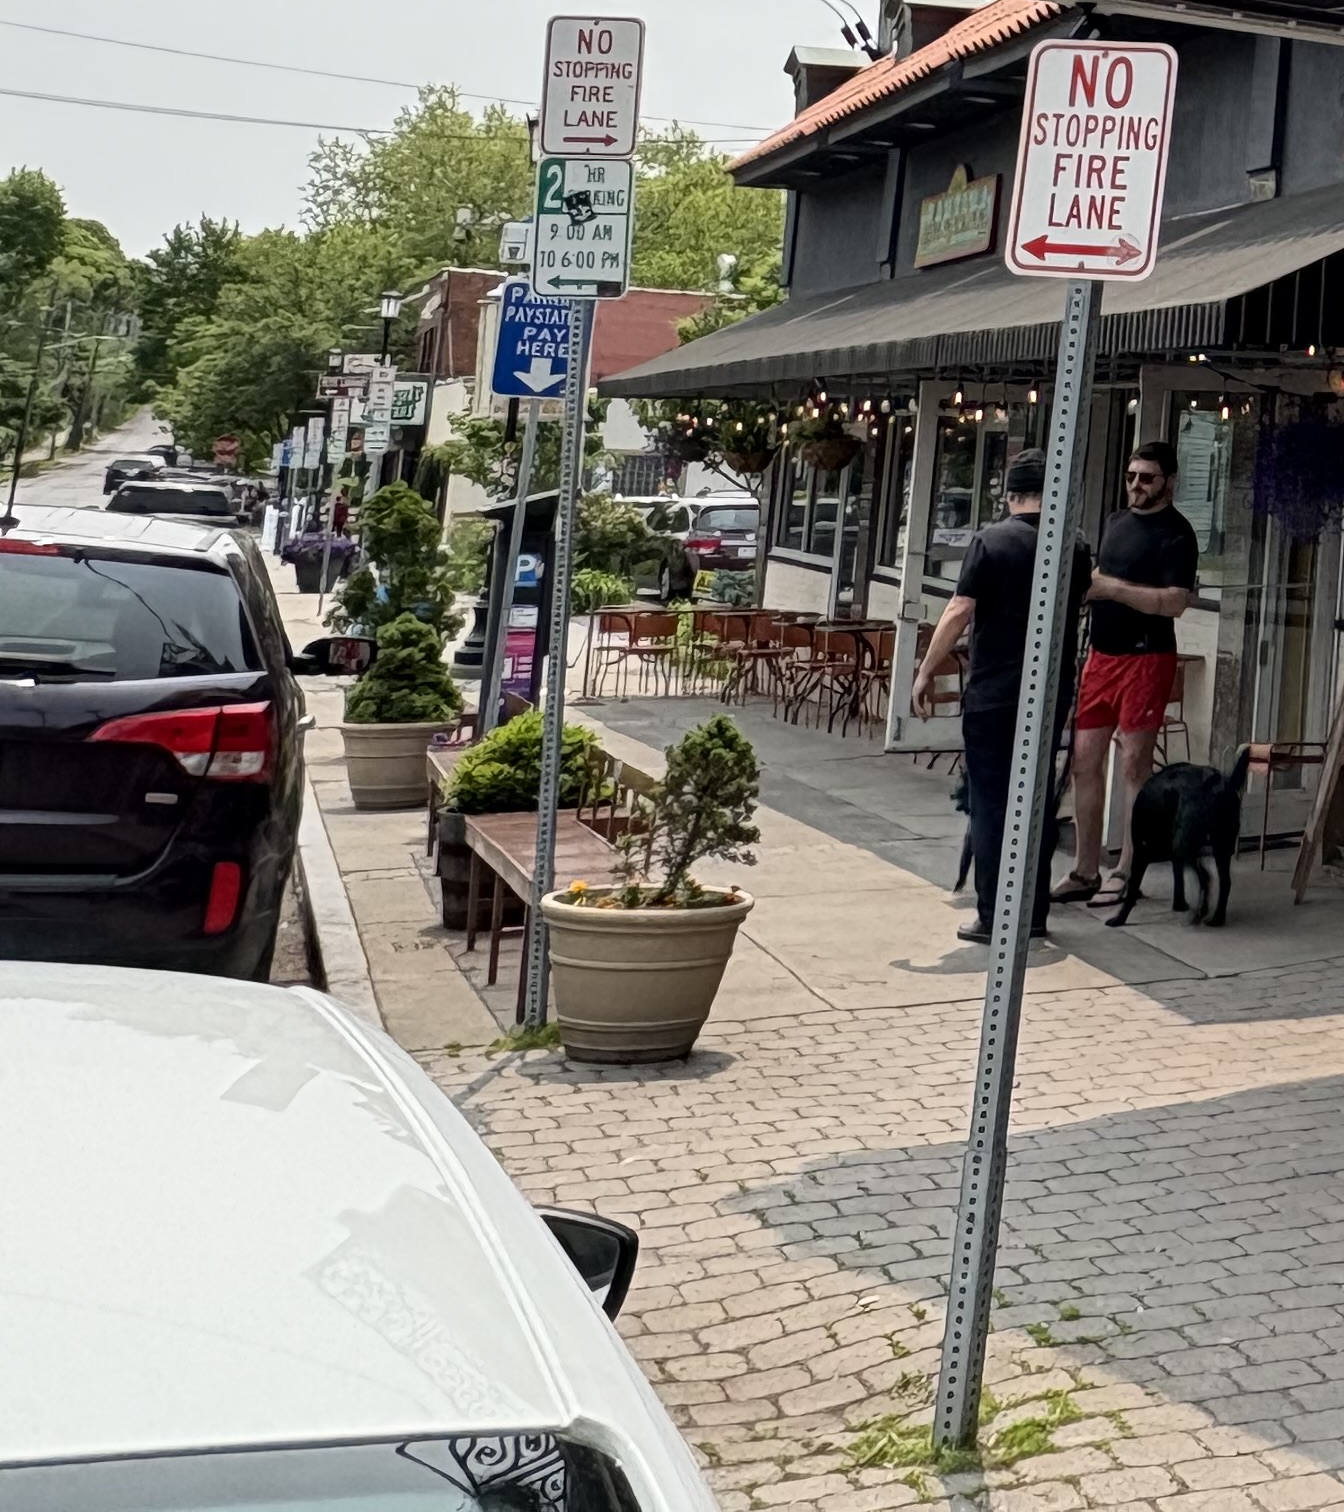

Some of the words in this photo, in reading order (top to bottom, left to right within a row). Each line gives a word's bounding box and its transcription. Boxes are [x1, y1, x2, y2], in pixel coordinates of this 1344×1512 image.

[577, 28, 613, 55] NO
[553, 60, 633, 80] STOPPING
[1068, 54, 1134, 109] NO
[570, 84, 614, 103] FIRE
[563, 109, 619, 128] LANE
[1034, 112, 1159, 151] STOPPING
[586, 166, 606, 184] HR
[1053, 153, 1131, 190] FIRE
[543, 164, 563, 209] 2
[1048, 192, 1126, 230] LANE
[550, 223, 585, 241] 900
[592, 224, 613, 241] AM
[540, 250, 556, 268] TO
[561, 251, 595, 269] 6:00
[601, 251, 620, 269] PM
[523, 326, 567, 342] PAY
[516, 340, 569, 358] HERE
[515, 554, 537, 581] P
